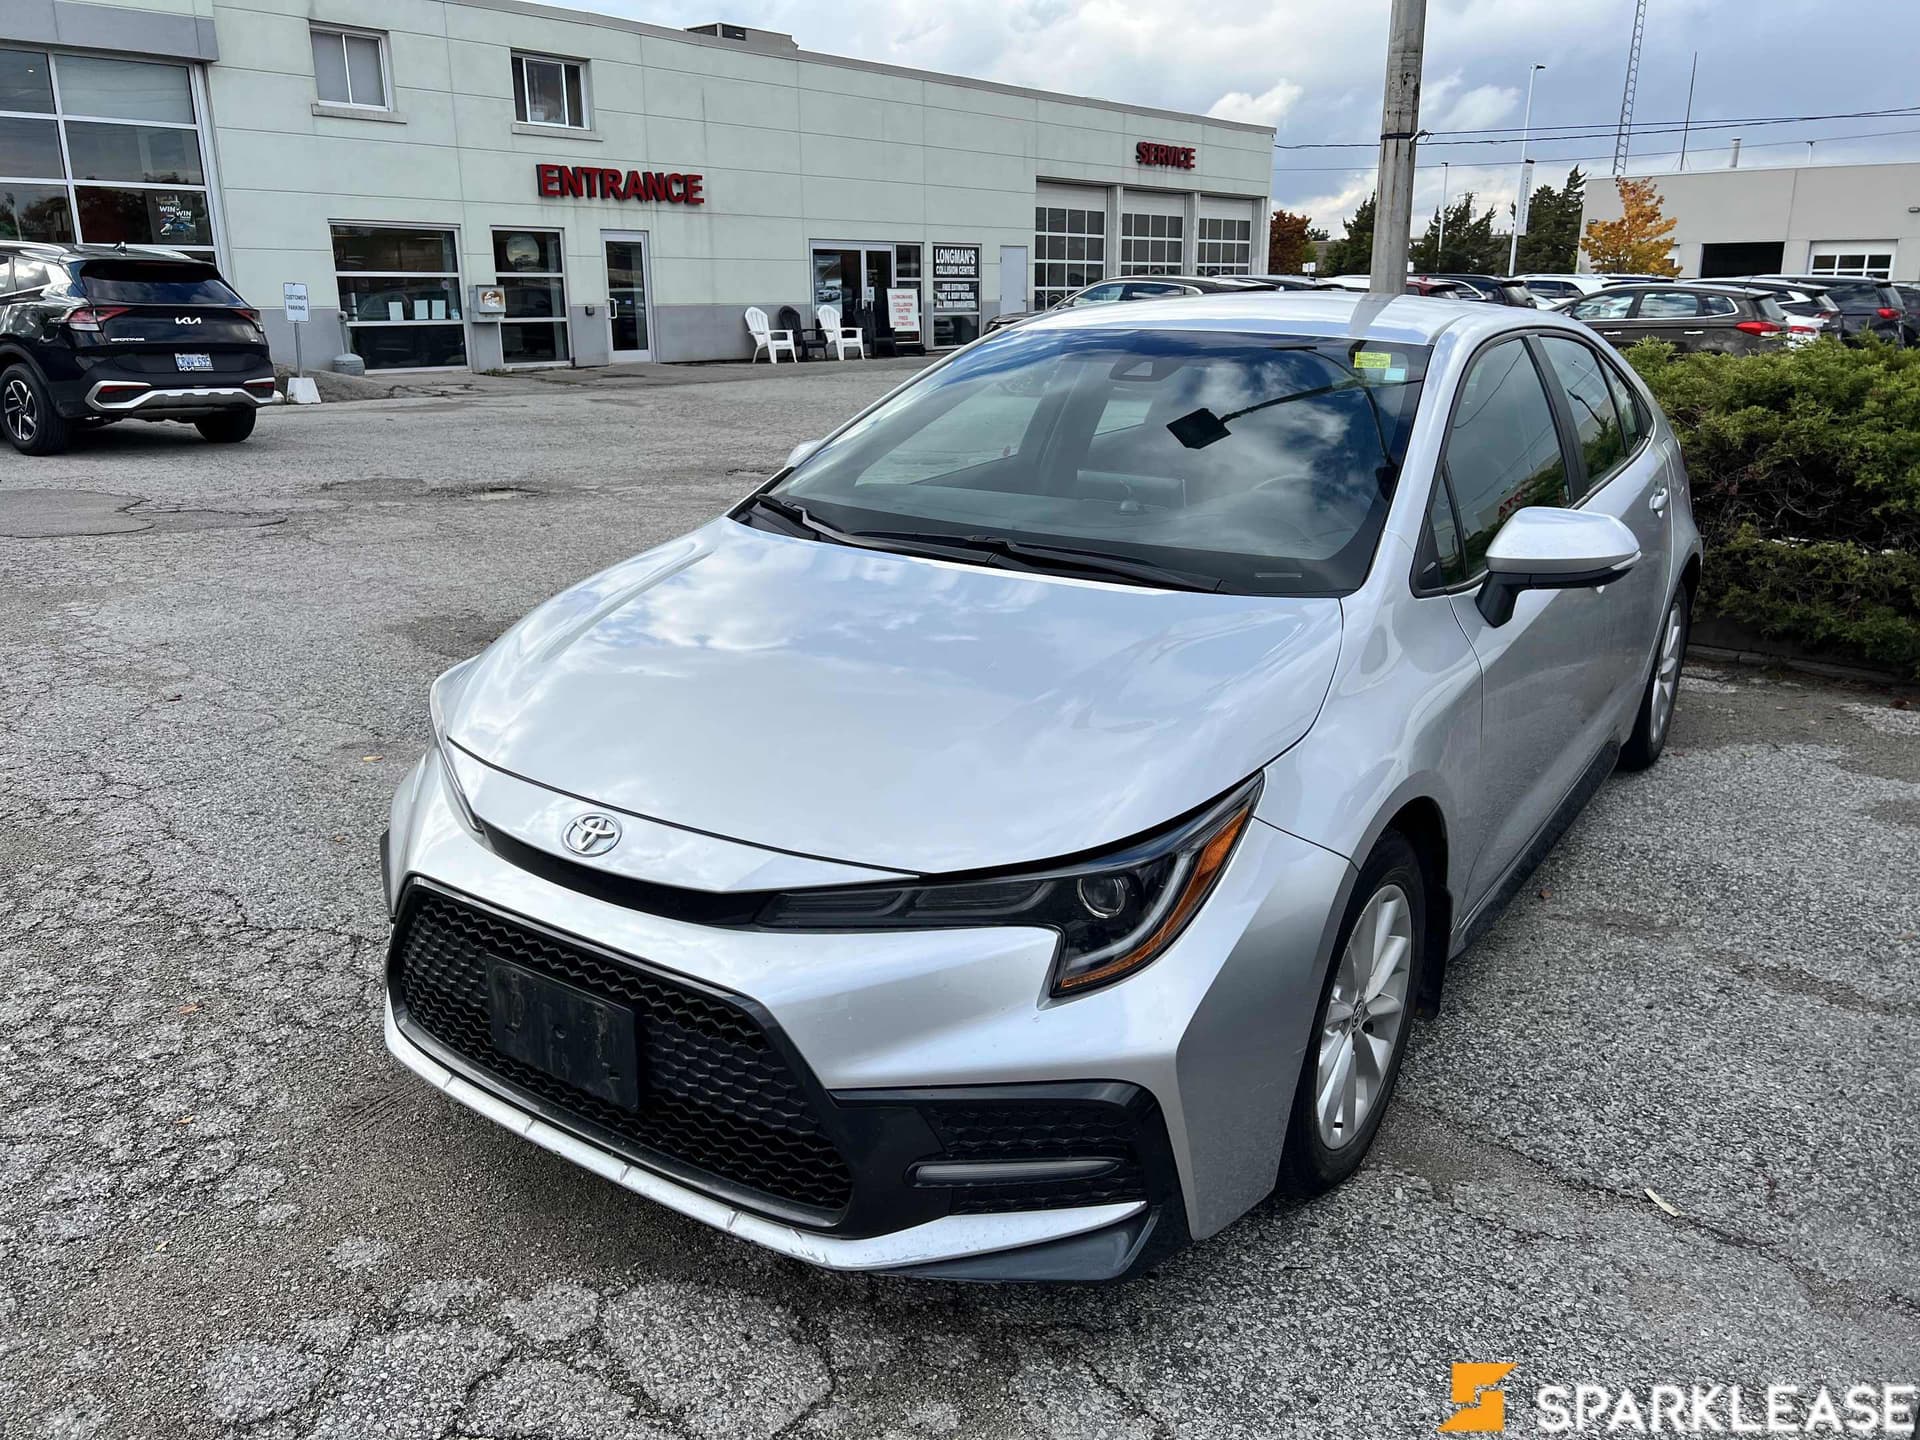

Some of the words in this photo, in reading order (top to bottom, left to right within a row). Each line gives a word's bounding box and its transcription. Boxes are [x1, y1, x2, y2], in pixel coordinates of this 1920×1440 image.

[1136, 141, 1196, 170] SERVICE
[536, 164, 704, 204] ENTRANCE
[935, 248, 976, 265] LONGMAN'S
[936, 265, 959, 275] COLLISION
[959, 265, 976, 275] CENTRE
[288, 304, 306, 312] PARKING
[175, 317, 202, 325] KIA
